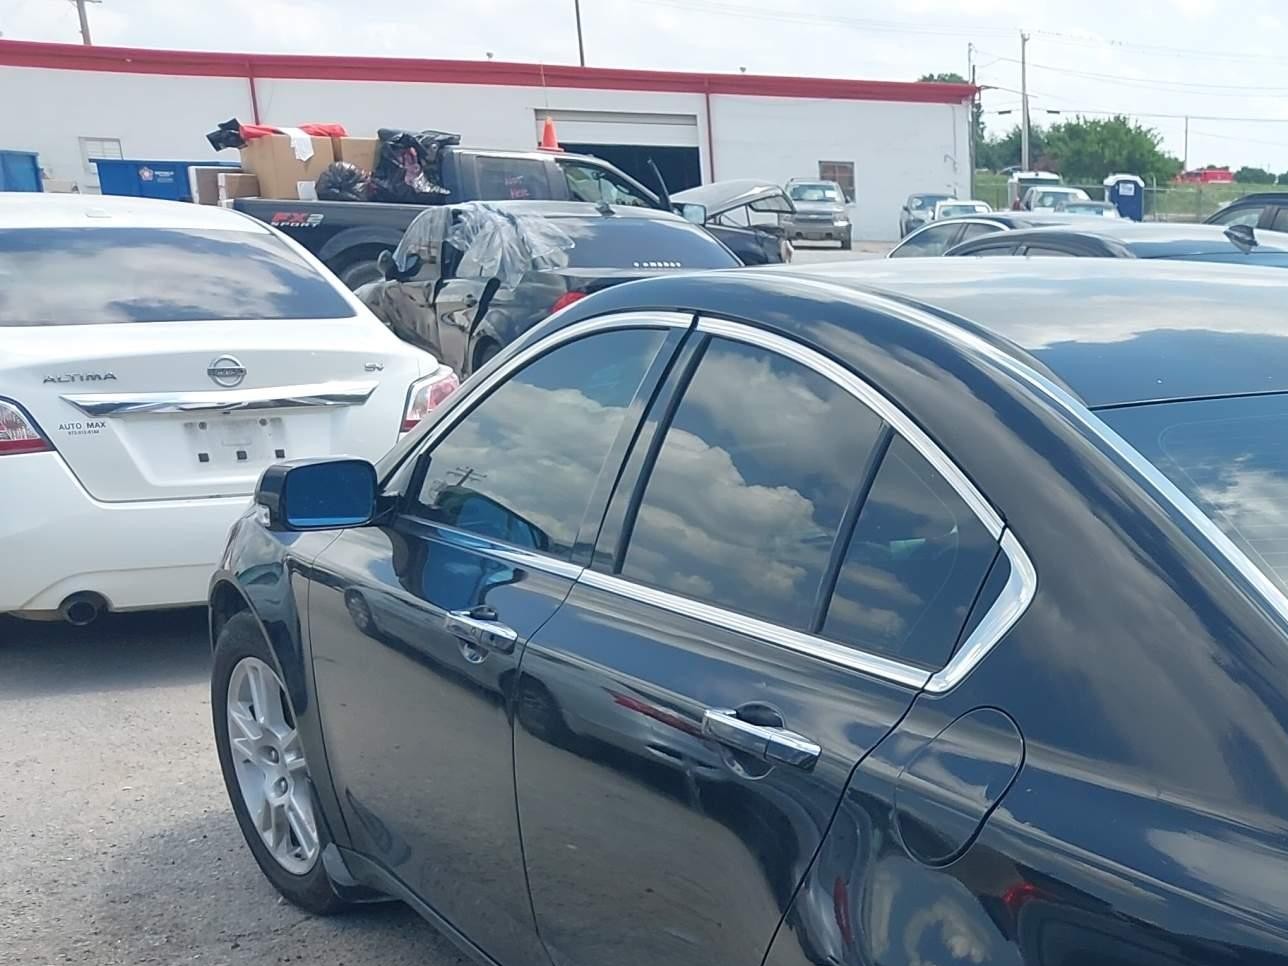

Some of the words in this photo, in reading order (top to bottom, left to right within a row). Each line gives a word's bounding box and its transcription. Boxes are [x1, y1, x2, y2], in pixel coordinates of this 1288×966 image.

[43, 373, 118, 384] ALTIMA
[59, 422, 82, 431] AUTO
[87, 421, 106, 429] MAX
